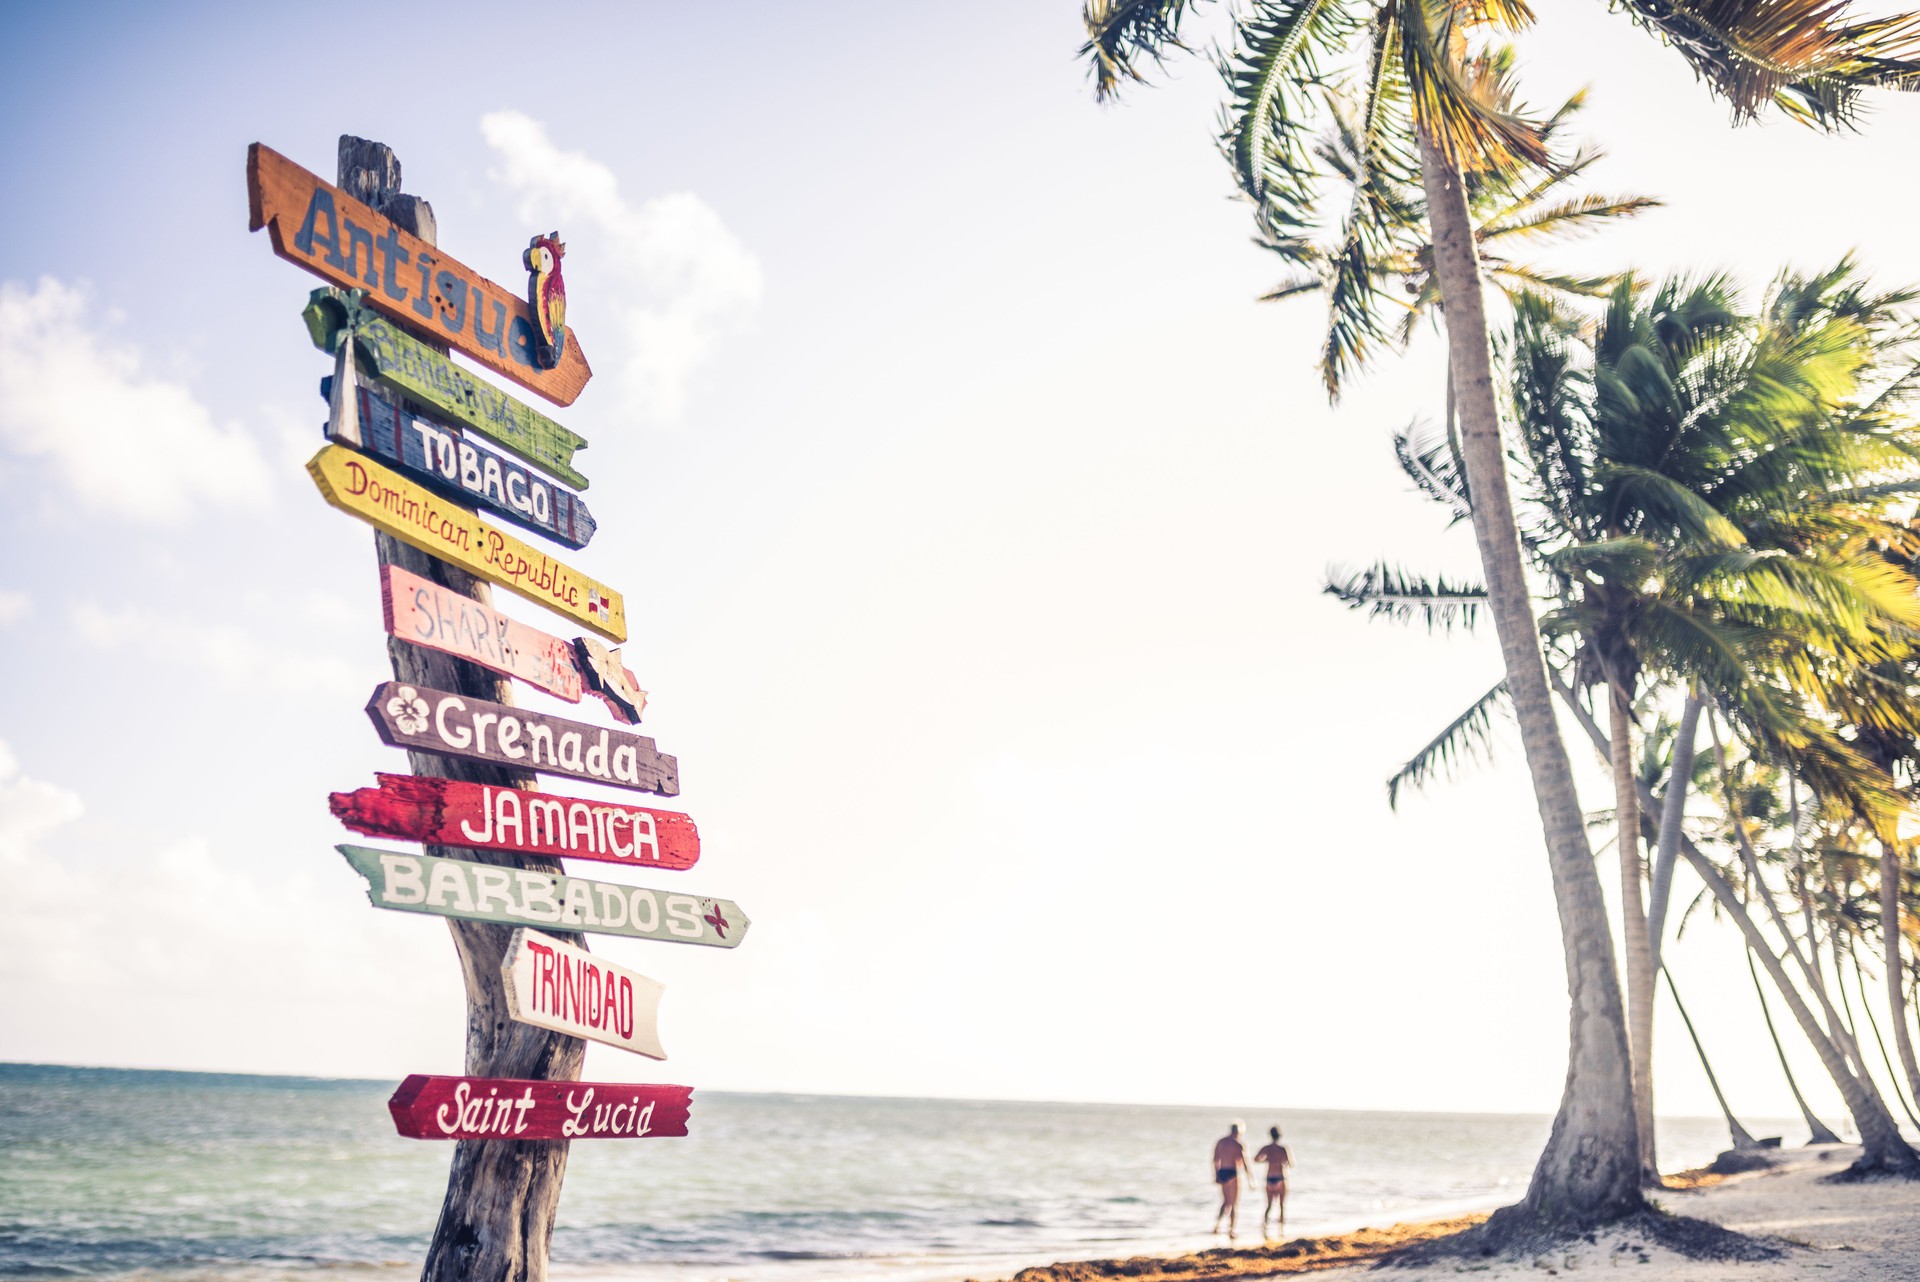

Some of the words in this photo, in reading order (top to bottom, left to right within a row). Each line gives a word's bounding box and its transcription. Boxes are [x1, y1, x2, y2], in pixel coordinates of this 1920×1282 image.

[412, 420, 549, 523] TOBAGO
[343, 461, 470, 552] Dominican
[485, 530, 579, 608] Republic
[414, 587, 516, 668] SHARK
[435, 696, 640, 784] Grenada
[460, 786, 660, 861] JAMAICA
[378, 854, 704, 938] BARBADOS
[527, 940, 634, 1040] TRINIDAD
[436, 1081, 536, 1135] Saint
